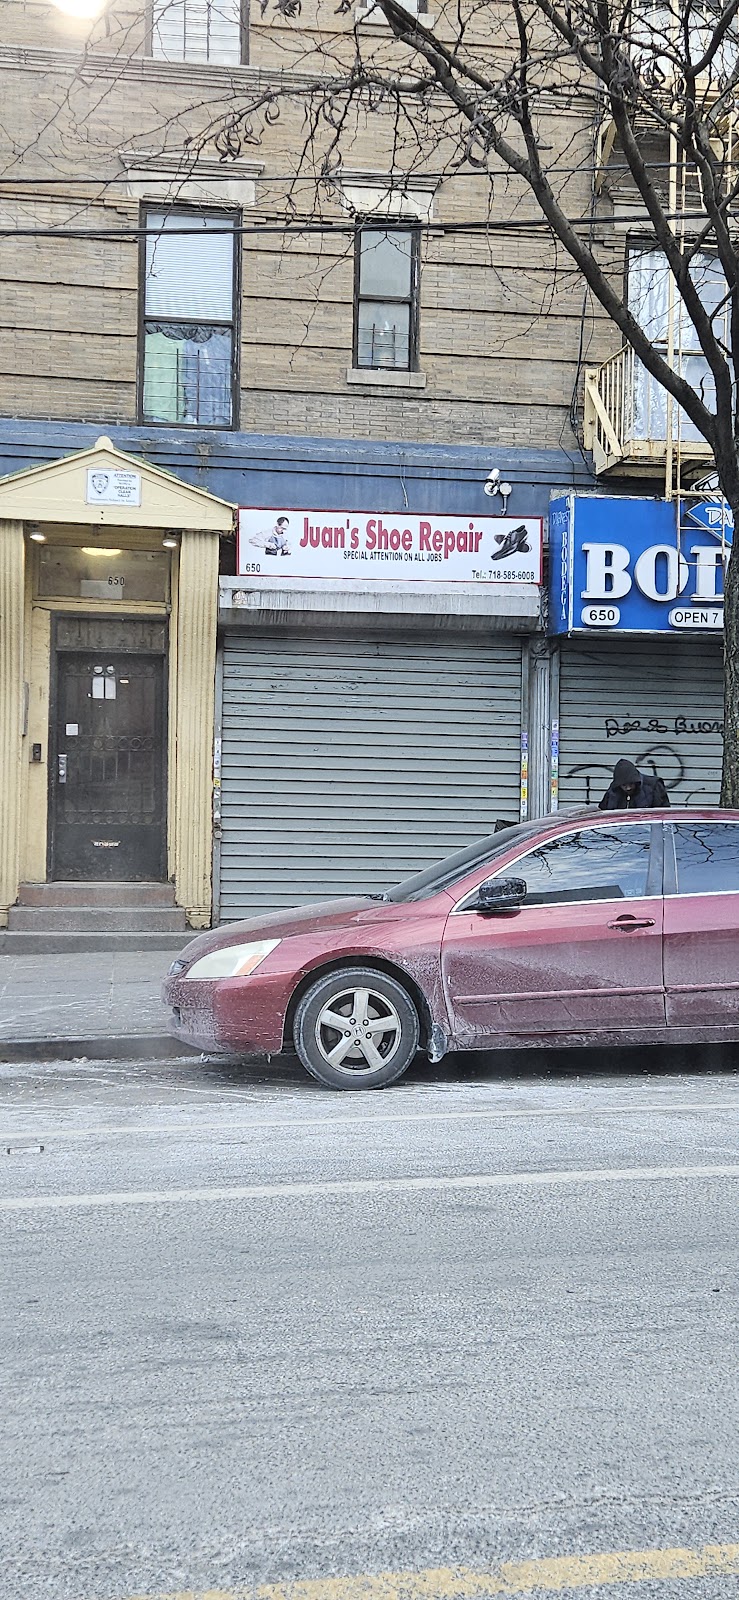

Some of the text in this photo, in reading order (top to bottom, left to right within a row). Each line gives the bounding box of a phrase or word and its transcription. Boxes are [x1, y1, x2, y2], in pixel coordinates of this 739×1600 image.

[300, 517, 483, 559] Juan's Shoe Repair
[343, 550, 443, 562] SPECIAL ATTENTION ON ALL JOBS
[245, 563, 261, 573] 650
[107, 576, 125, 586] 650
[560, 531, 568, 620] BODEGA
[589, 609, 615, 621] 650
[674, 611, 719, 623] OPEN 7
